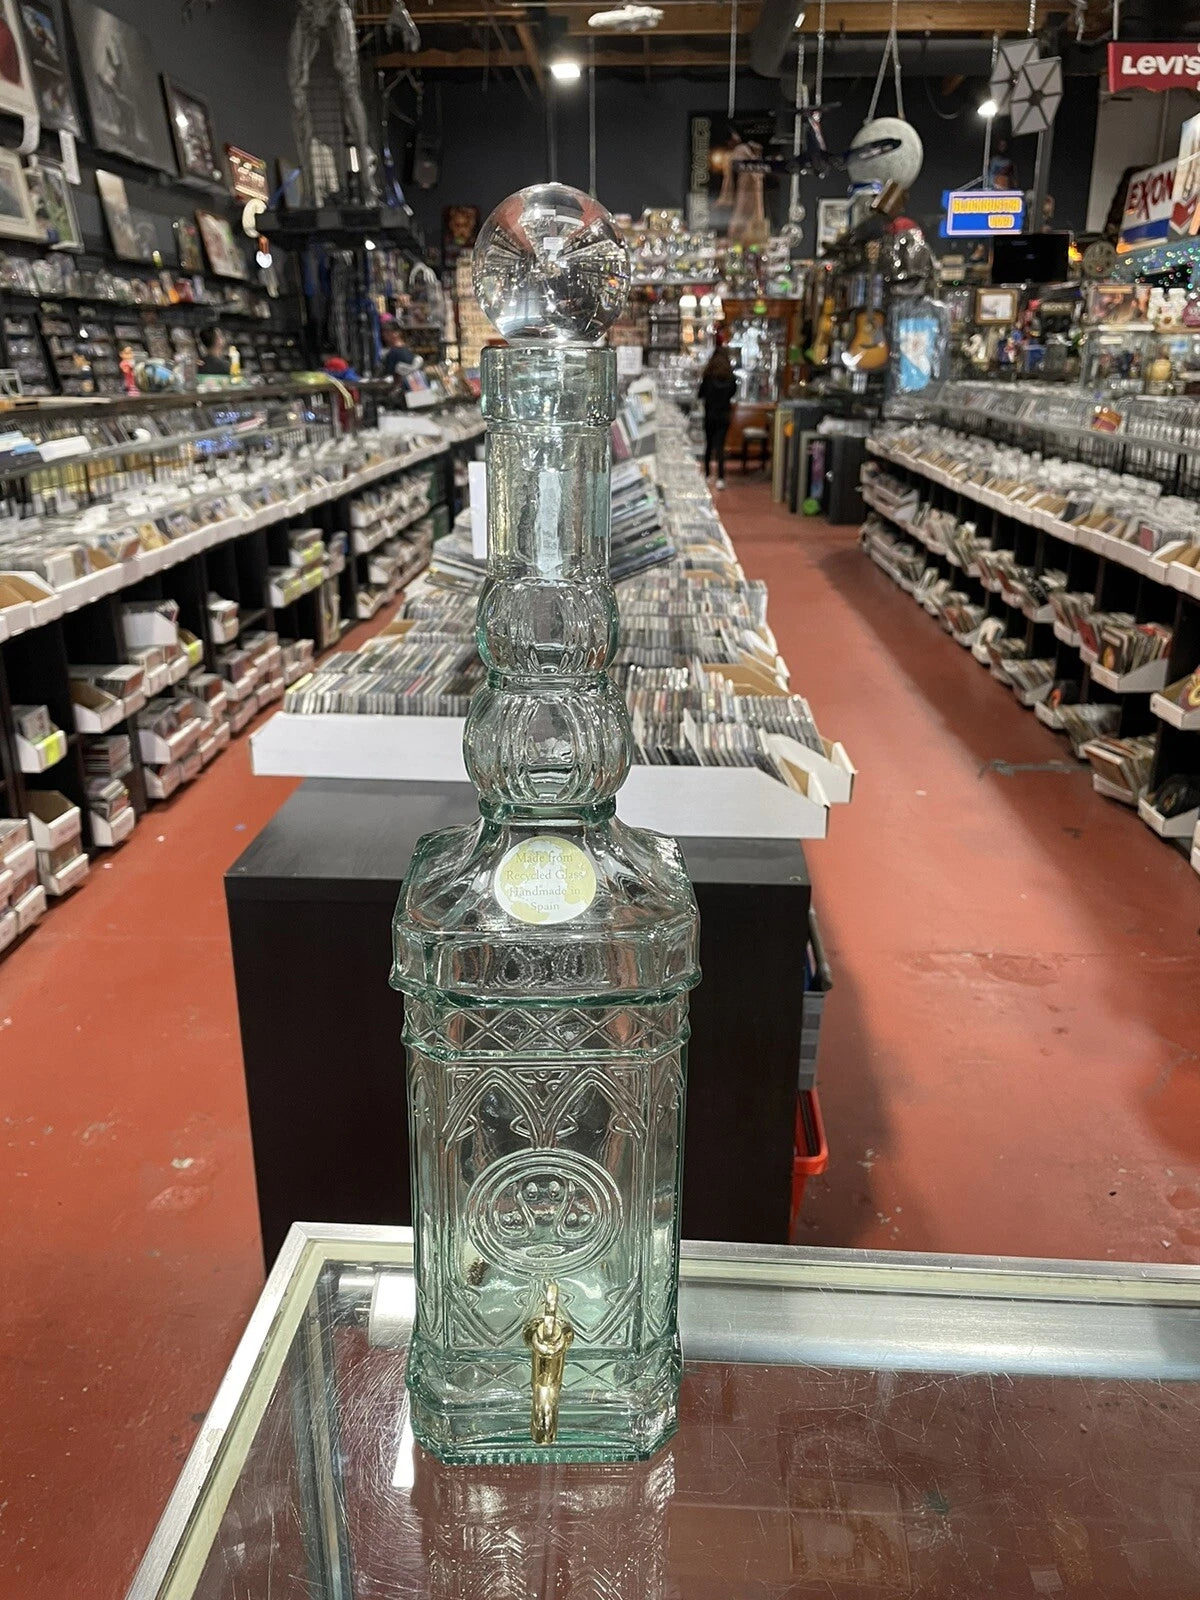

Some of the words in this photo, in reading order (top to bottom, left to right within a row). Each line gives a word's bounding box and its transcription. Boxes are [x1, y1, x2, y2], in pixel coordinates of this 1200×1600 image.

[516, 851, 544, 863] Made
[548, 850, 573, 863] from
[506, 870, 551, 882] Recycled
[555, 869, 585, 881] Glass
[509, 886, 567, 897] Handmade
[570, 887, 580, 896] in
[530, 902, 560, 913] Spain
